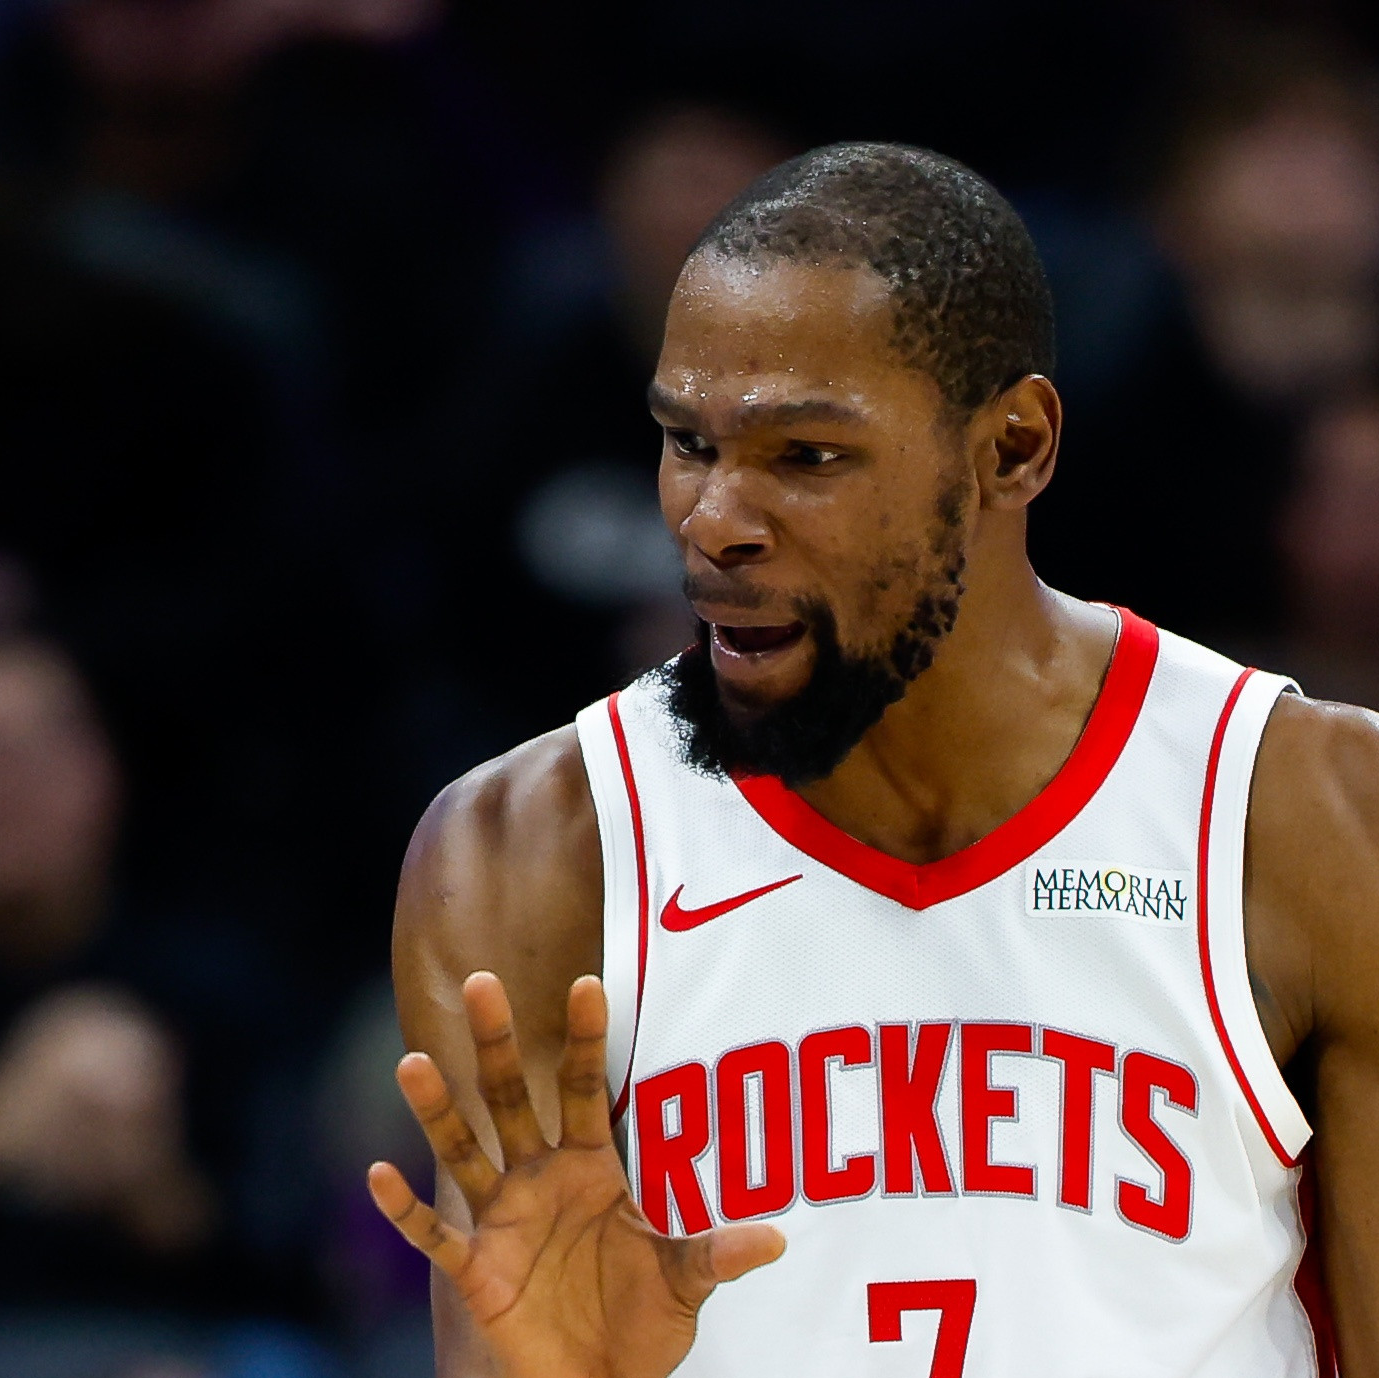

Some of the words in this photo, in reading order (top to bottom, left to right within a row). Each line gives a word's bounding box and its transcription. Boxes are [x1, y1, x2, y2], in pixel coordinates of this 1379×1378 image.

[1033, 868, 1187, 901] MEMORIAL
[1033, 888, 1185, 920] HERMANN
[632, 1018, 1200, 1245] ROCKETS
